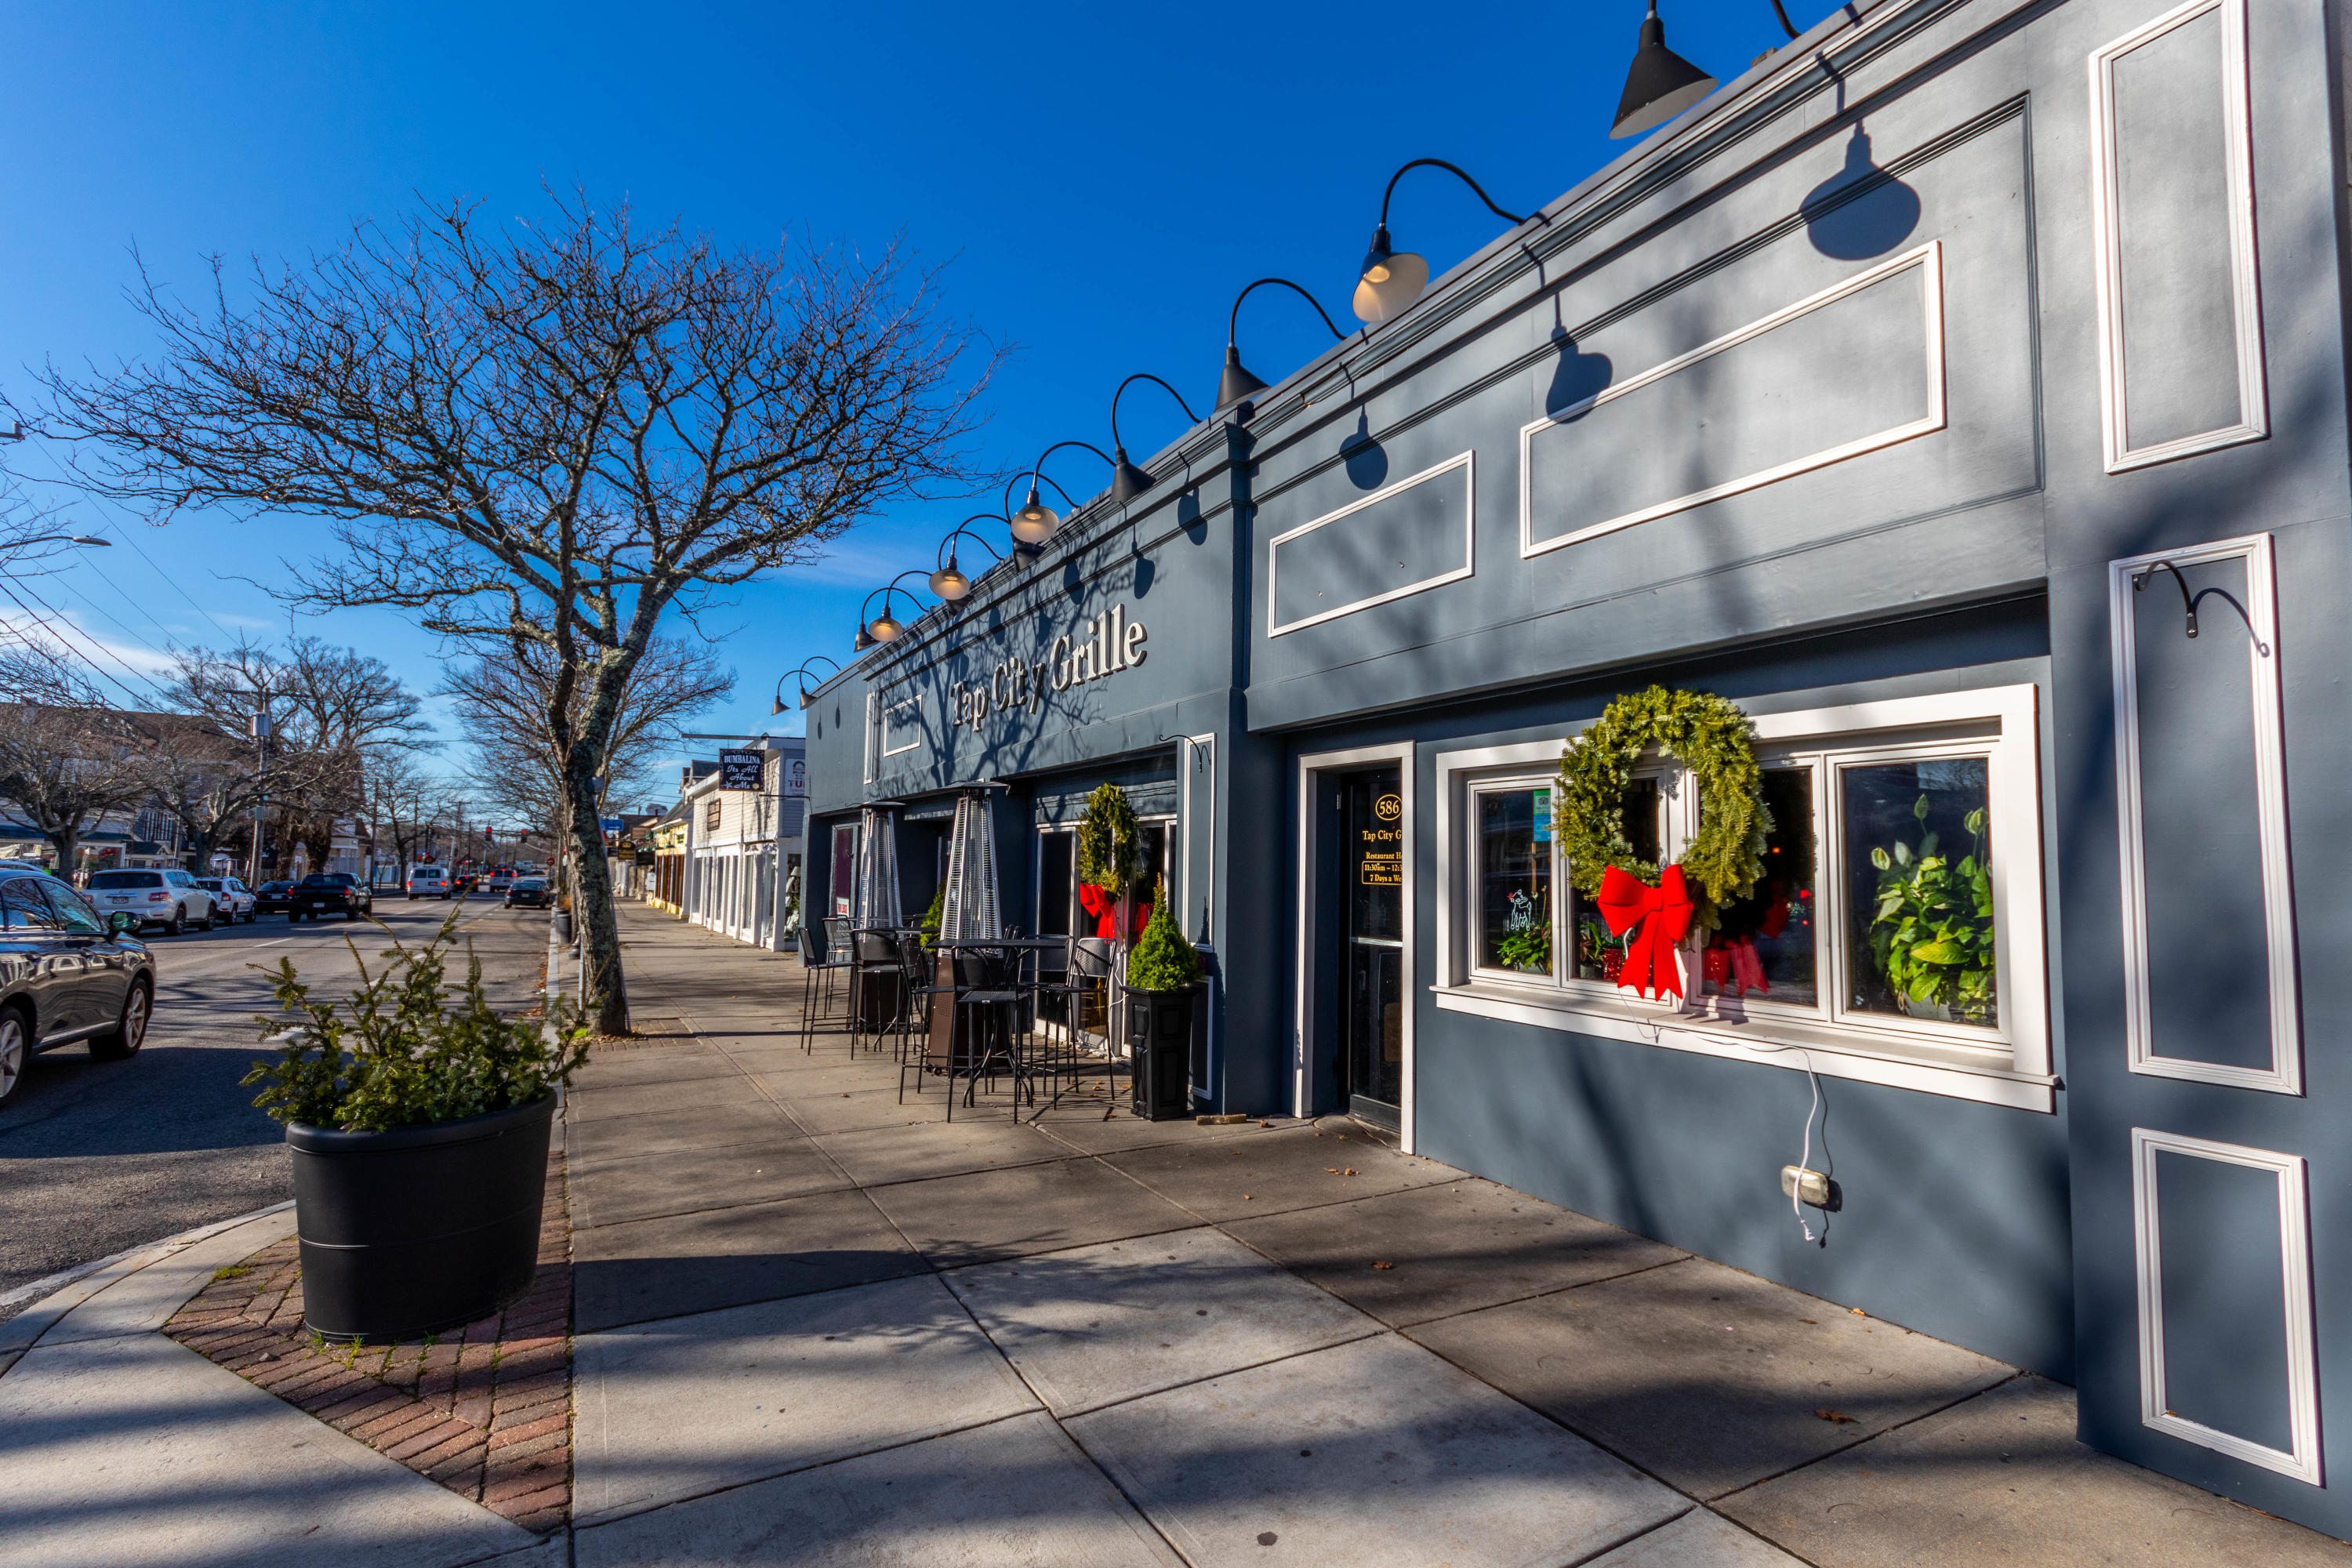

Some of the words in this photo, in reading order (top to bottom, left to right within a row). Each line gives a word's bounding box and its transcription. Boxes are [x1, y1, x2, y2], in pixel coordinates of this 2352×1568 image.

[950, 681, 989, 732] Tap
[992, 657, 1045, 715] City
[1050, 604, 1148, 692] Grille
[724, 755, 760, 764] BUMBALINA
[741, 764, 759, 773] All
[730, 772, 755, 781] About
[734, 781, 751, 789] Me
[1379, 800, 1399, 815] 586
[1362, 830, 1376, 842] Tap
[1377, 829, 1394, 842] City
[1374, 873, 1388, 883] Days
